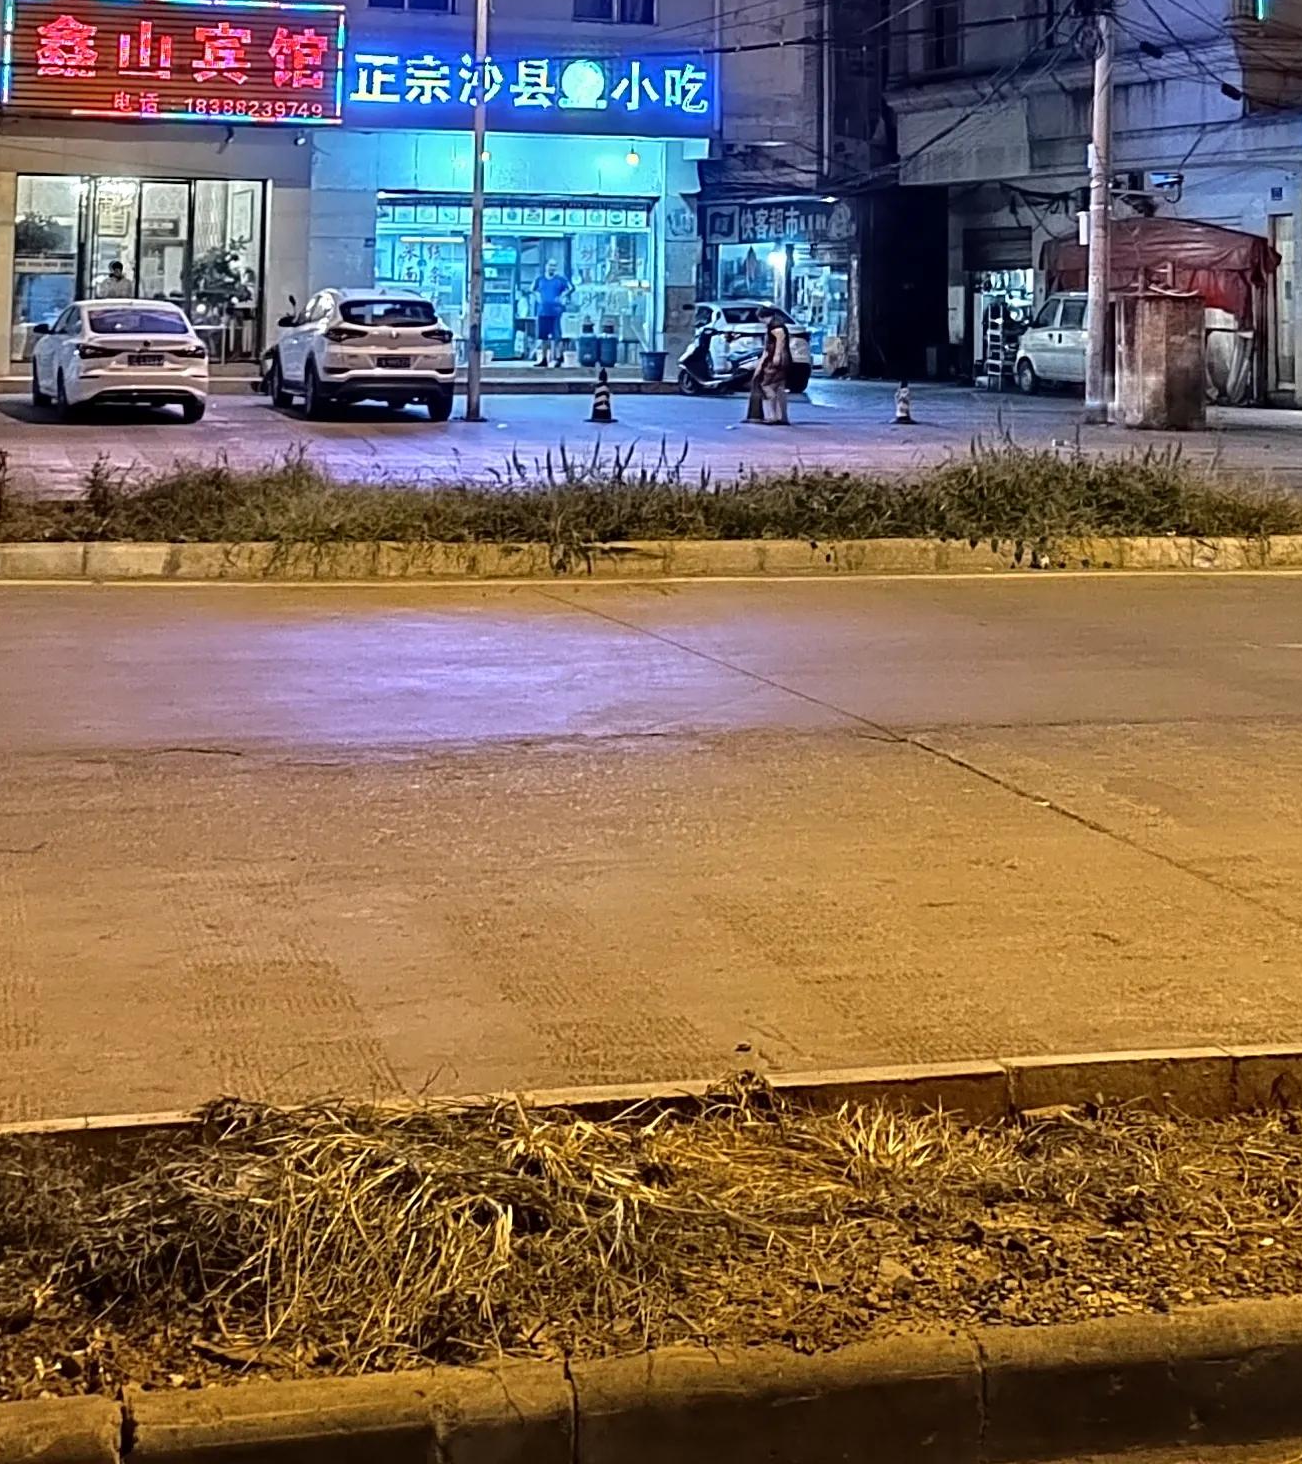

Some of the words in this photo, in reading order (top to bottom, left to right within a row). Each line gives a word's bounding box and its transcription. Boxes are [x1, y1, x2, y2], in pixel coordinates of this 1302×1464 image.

[37, 14, 328, 89] 鑫山宾馆
[350, 53, 556, 109] 正宗沙县
[611, 61, 709, 113] 小吃
